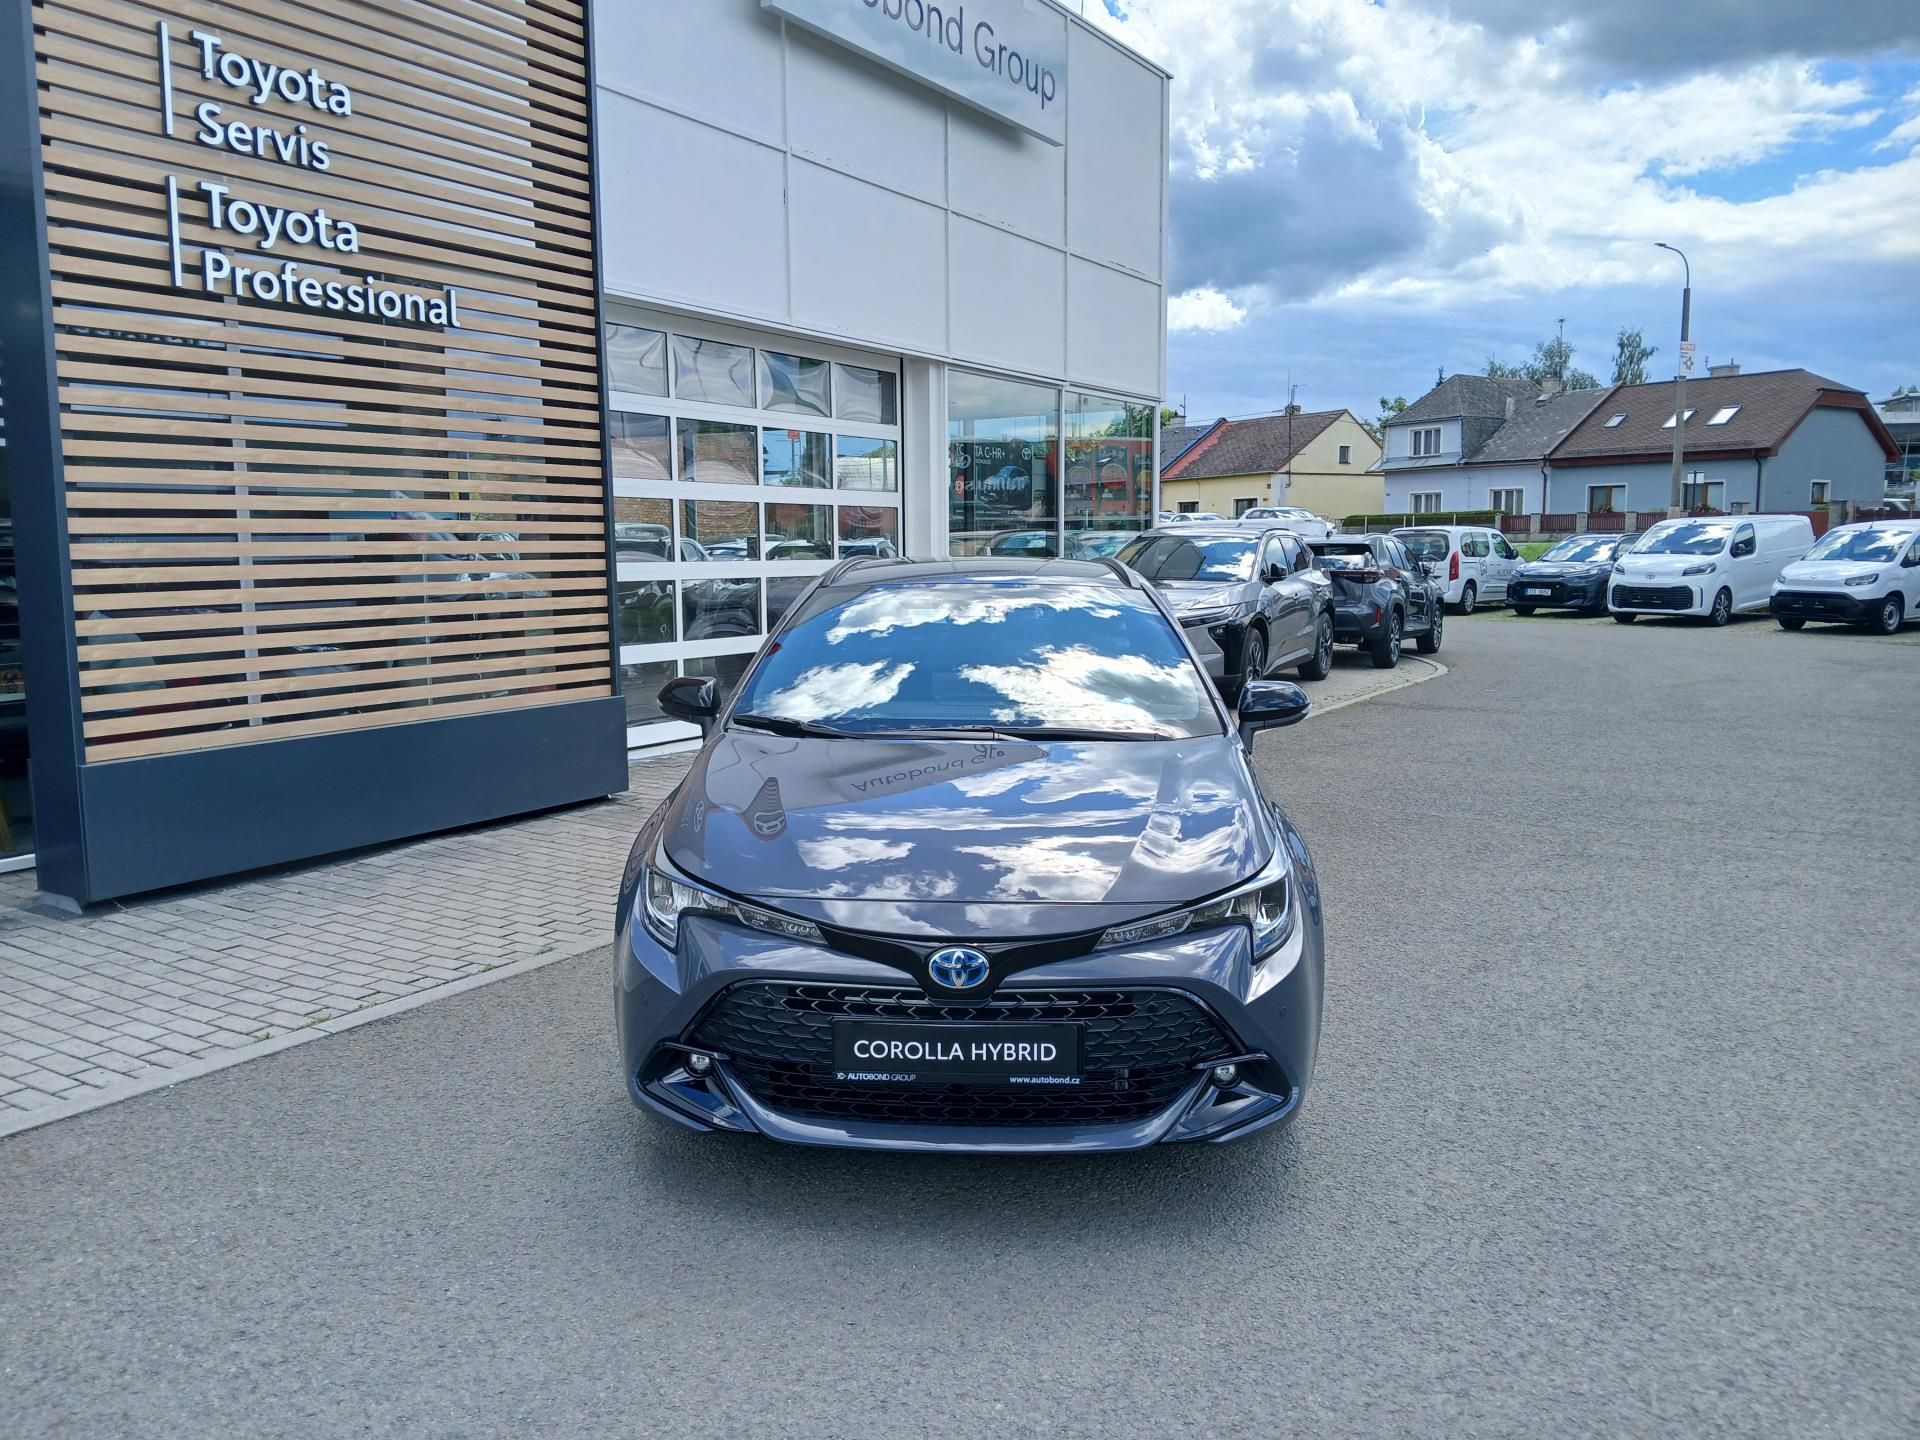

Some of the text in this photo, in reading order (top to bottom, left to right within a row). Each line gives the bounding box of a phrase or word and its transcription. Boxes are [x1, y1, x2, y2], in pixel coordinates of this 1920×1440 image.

[190, 30, 352, 116] Toyota
[974, 21, 1056, 110] Group
[195, 102, 331, 170] Servis
[197, 181, 360, 253] Toyota
[201, 250, 461, 327] Professional
[847, 1073, 917, 1082] AUTOBOND GROUP
[853, 1040, 1057, 1061] COROLLA HYBRID
[1009, 1076, 1081, 1085] www.autobond.cz
